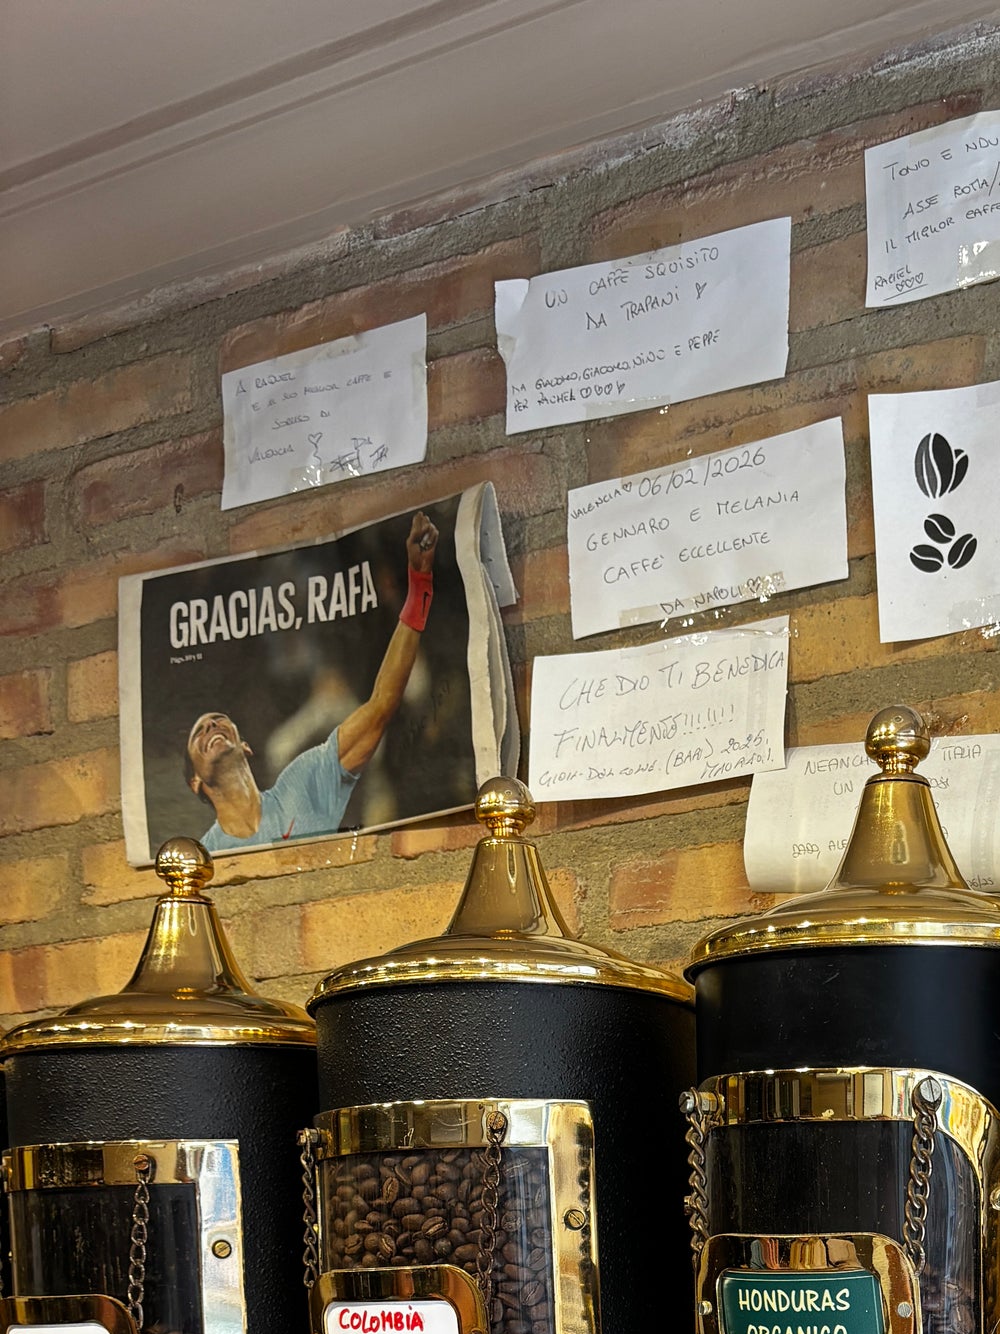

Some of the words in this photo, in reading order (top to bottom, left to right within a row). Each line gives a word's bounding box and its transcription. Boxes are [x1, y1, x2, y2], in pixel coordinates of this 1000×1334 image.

[941, 150, 952, 160] E
[903, 195, 939, 219] ASSE
[885, 240, 897, 253] IL
[586, 312, 608, 330] DA
[674, 345, 681, 356] E
[688, 330, 720, 350] PEPPE
[236, 380, 247, 396] A
[570, 489, 621, 520] VALENCIA
[586, 517, 670, 552] GENNARO
[689, 508, 701, 521] E
[716, 491, 800, 515] MELANIA
[678, 531, 771, 562] ECCELLENTE
[170, 582, 302, 649] GRACIAS,
[307, 561, 378, 623] RAFA
[660, 599, 684, 615] DA
[694, 586, 743, 607] NAPOLI
[559, 677, 608, 710] CHE
[615, 675, 650, 696] DIO
[658, 661, 683, 688] TI
[691, 650, 785, 690] BENEDICA
[834, 780, 854, 796] UN
[738, 1287, 850, 1313] HONDURAS
